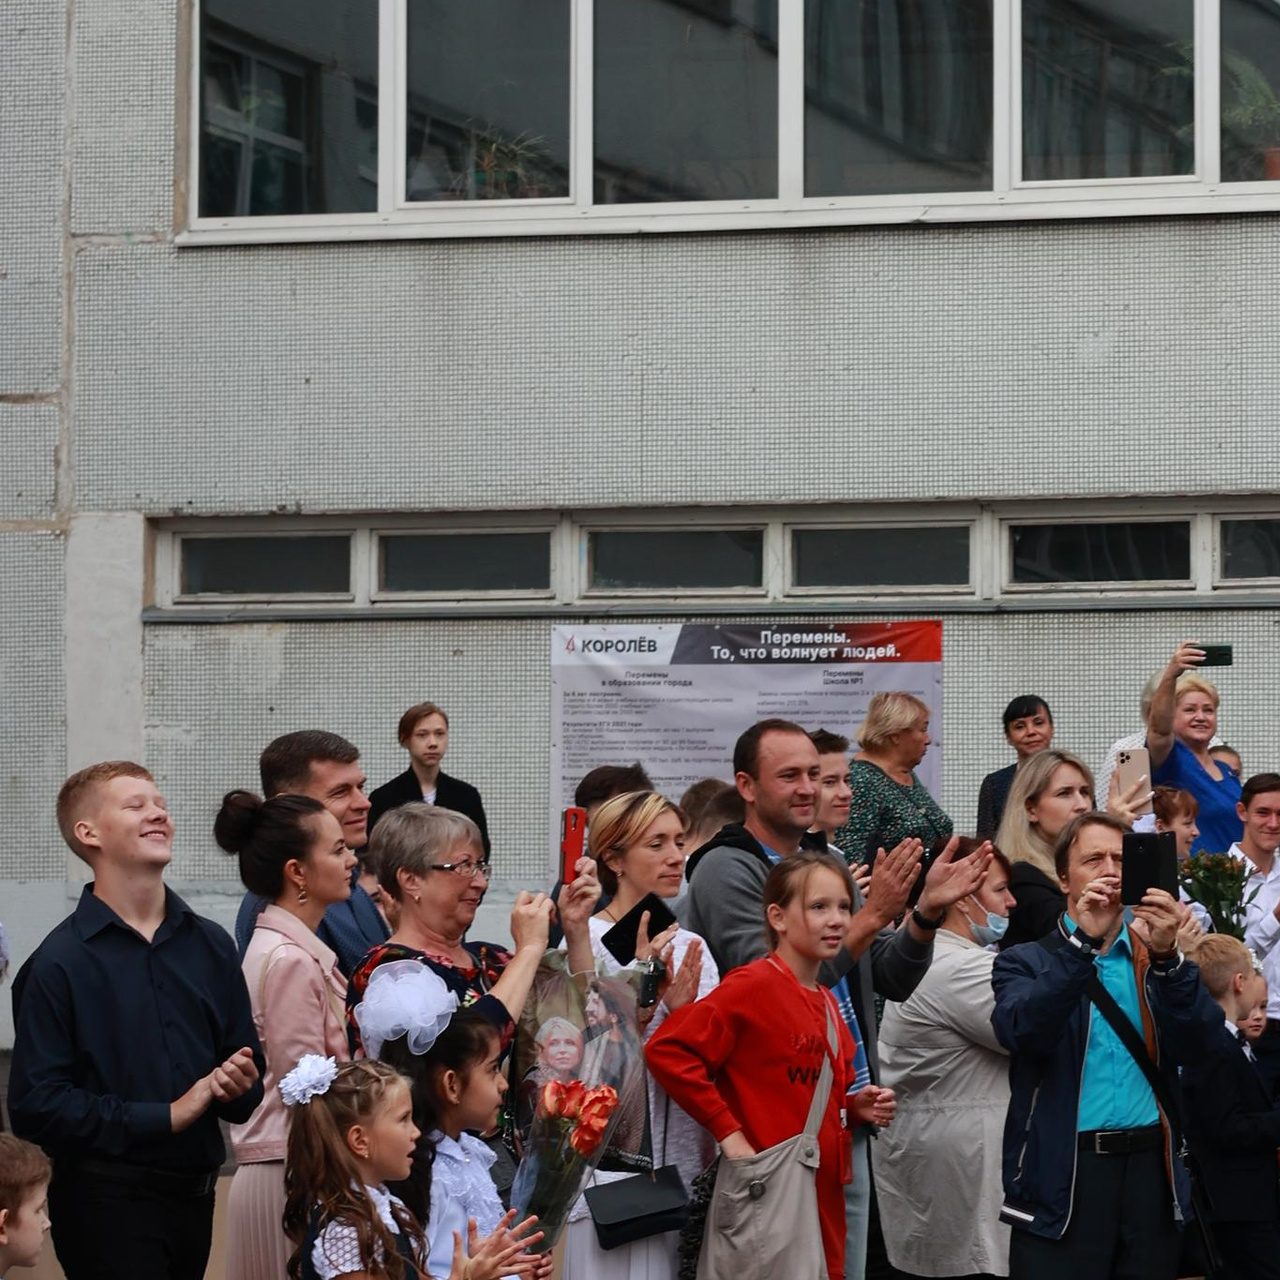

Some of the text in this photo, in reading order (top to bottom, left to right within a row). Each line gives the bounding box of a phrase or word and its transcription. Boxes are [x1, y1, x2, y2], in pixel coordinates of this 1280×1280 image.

[760, 630, 852, 646] Перемены.
[581, 636, 658, 654] КОРОЛЁВ
[710, 643, 901, 661] То, что волнует людей.
[625, 671, 669, 679] Перемены
[823, 670, 864, 678] Перемены
[608, 679, 662, 687] образовании
[823, 677, 849, 685] Школа
